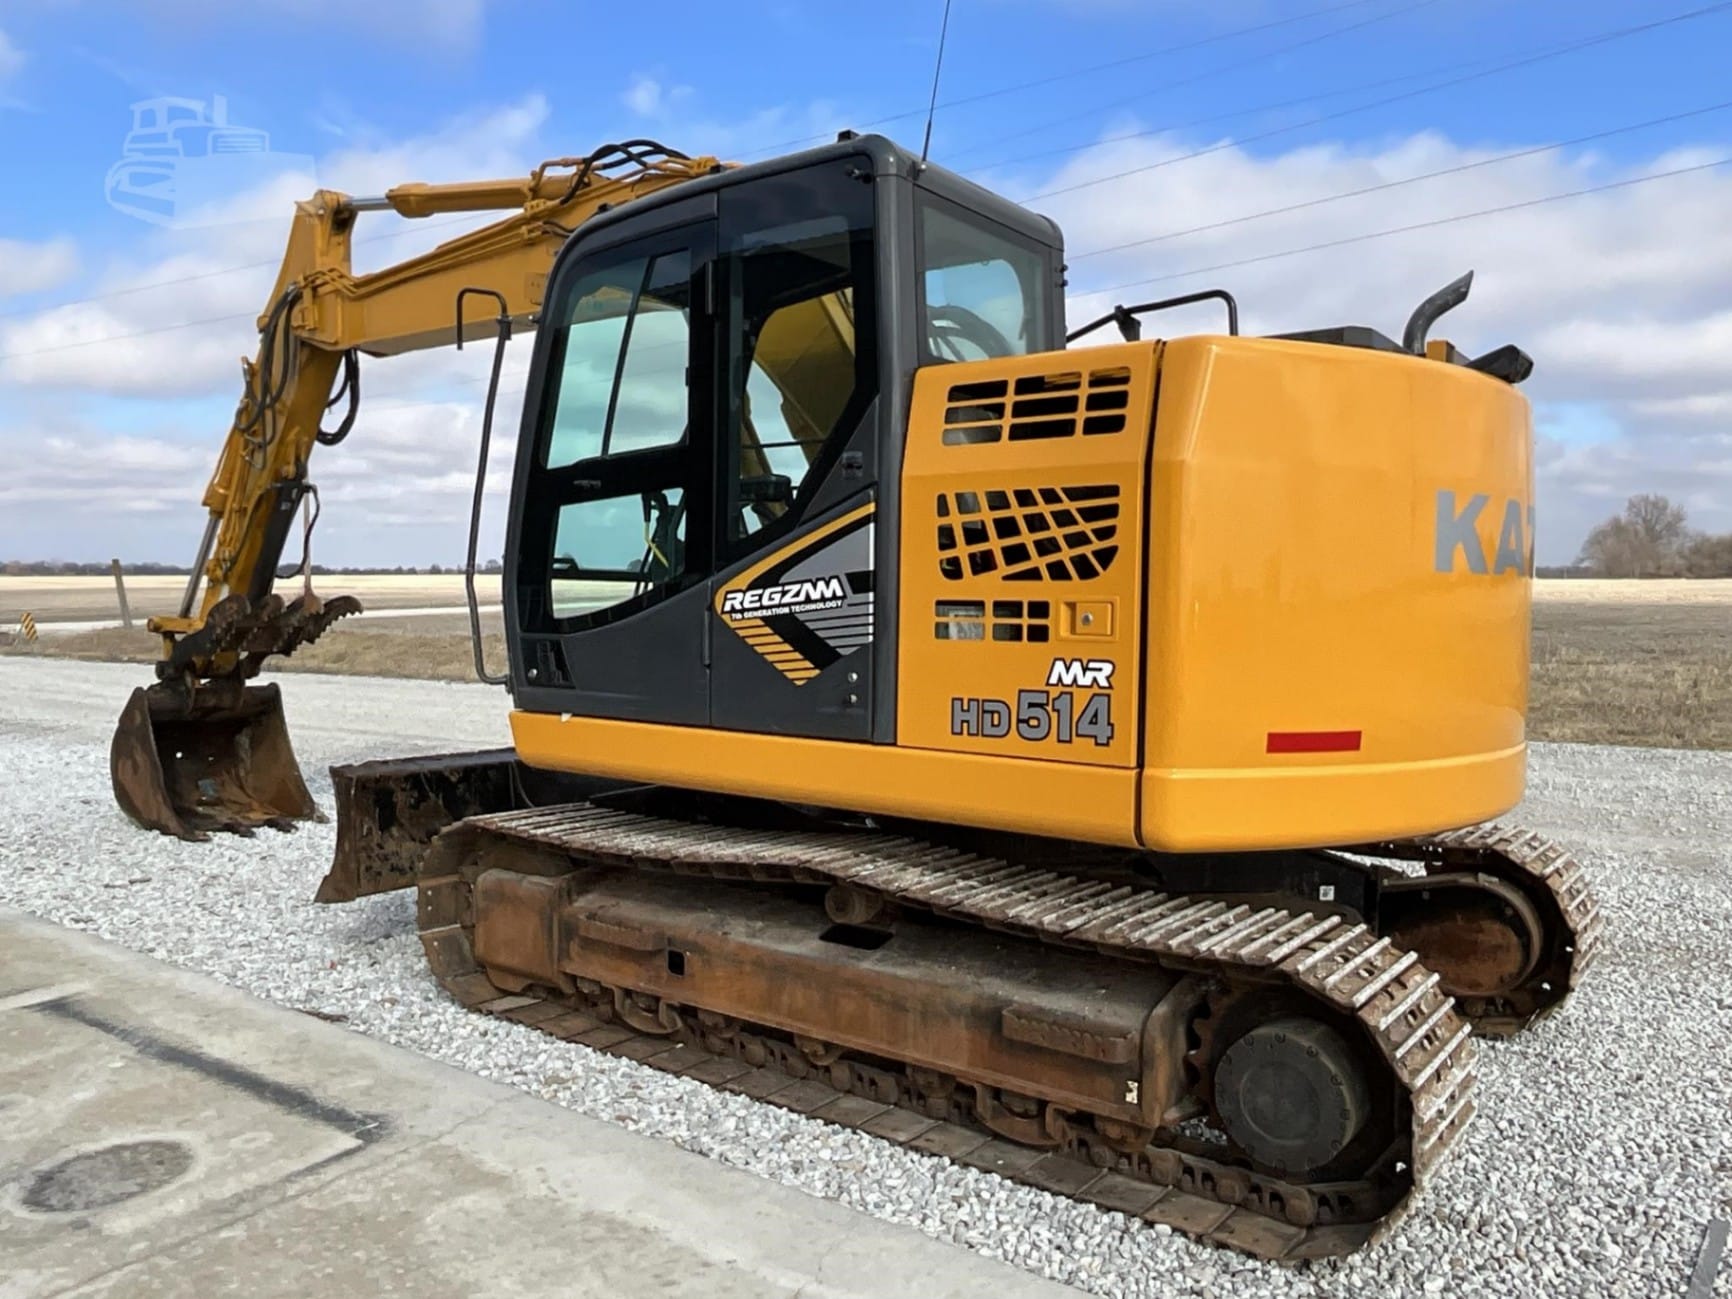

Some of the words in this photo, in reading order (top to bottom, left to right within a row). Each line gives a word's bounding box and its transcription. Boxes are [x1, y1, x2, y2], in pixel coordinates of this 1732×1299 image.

[723, 578, 844, 612] REGZAM
[744, 605, 790, 618] GENERATION
[791, 599, 842, 613] TECHNOLOGY
[1047, 659, 1114, 688] MR
